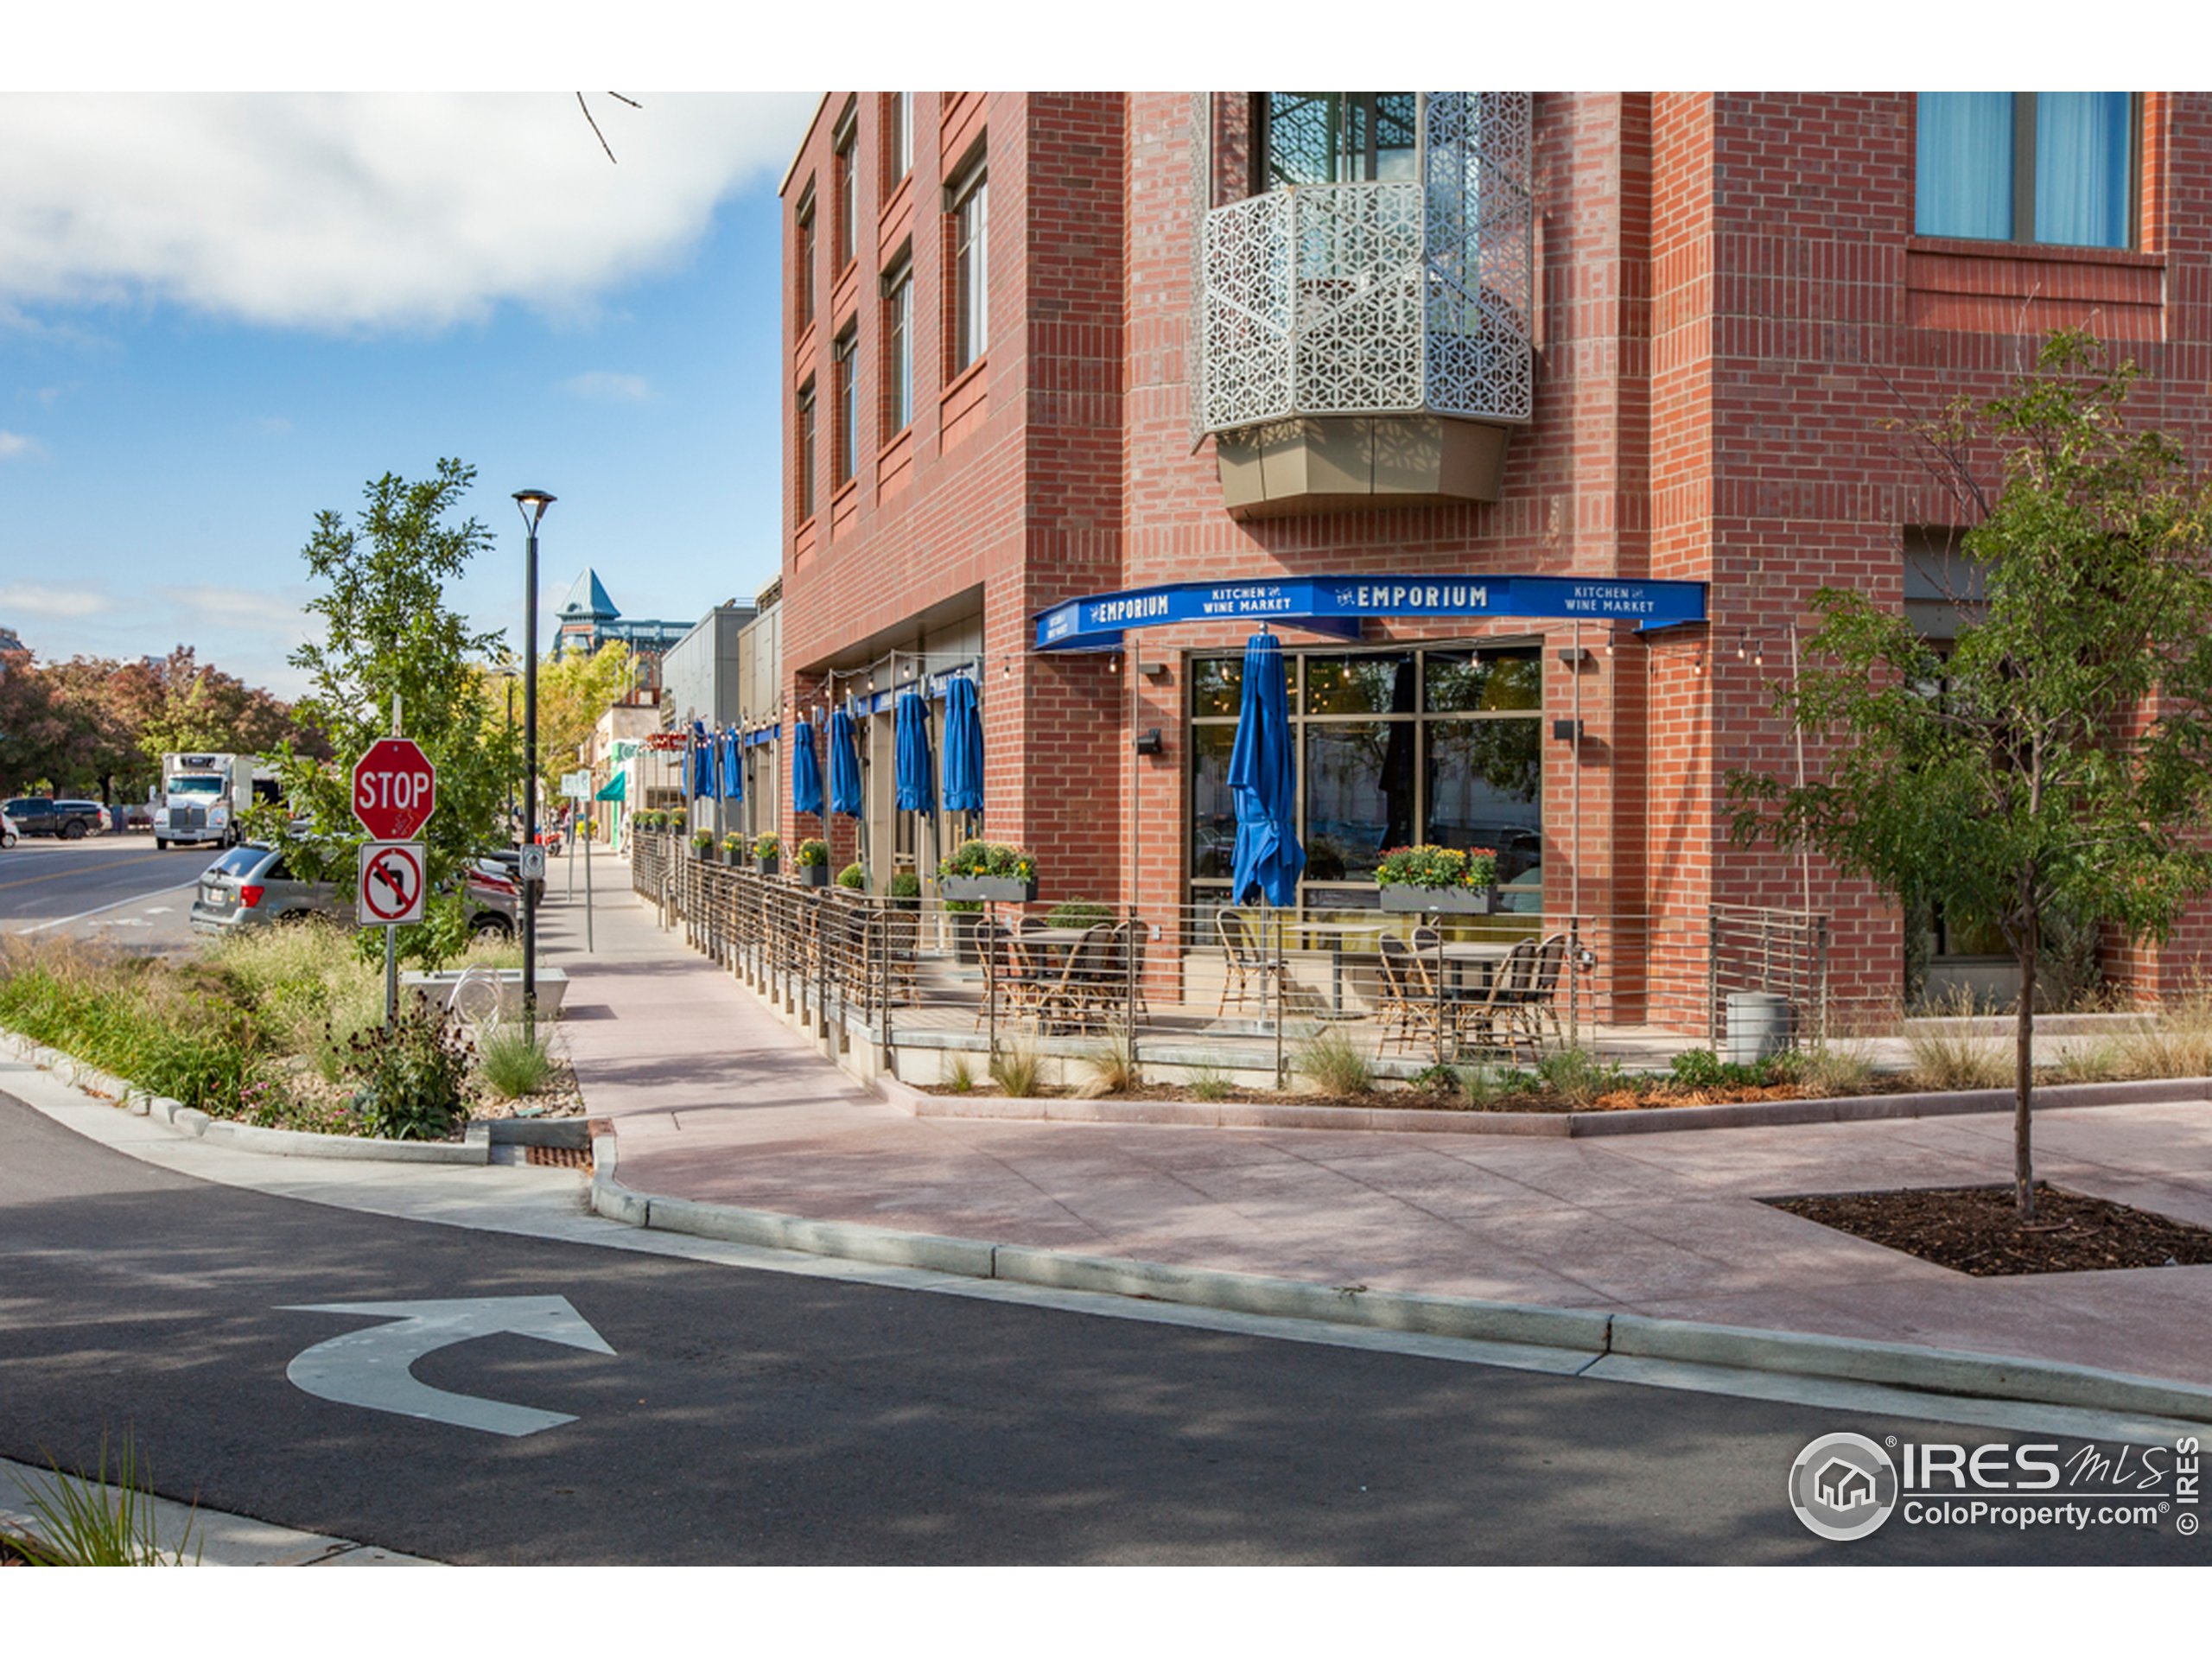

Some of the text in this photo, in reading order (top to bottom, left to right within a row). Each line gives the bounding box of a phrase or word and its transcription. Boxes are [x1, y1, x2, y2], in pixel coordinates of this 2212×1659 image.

[1211, 587, 1266, 601] KITCHEN
[1357, 586, 1487, 607] EMPORIUM
[1573, 586, 1630, 599] KITCHEN
[1099, 594, 1169, 623] EMPORIUM
[1203, 597, 1292, 613] WINE MARKET
[1564, 599, 1655, 613] WINE MARKET
[359, 771, 430, 810] STOP
